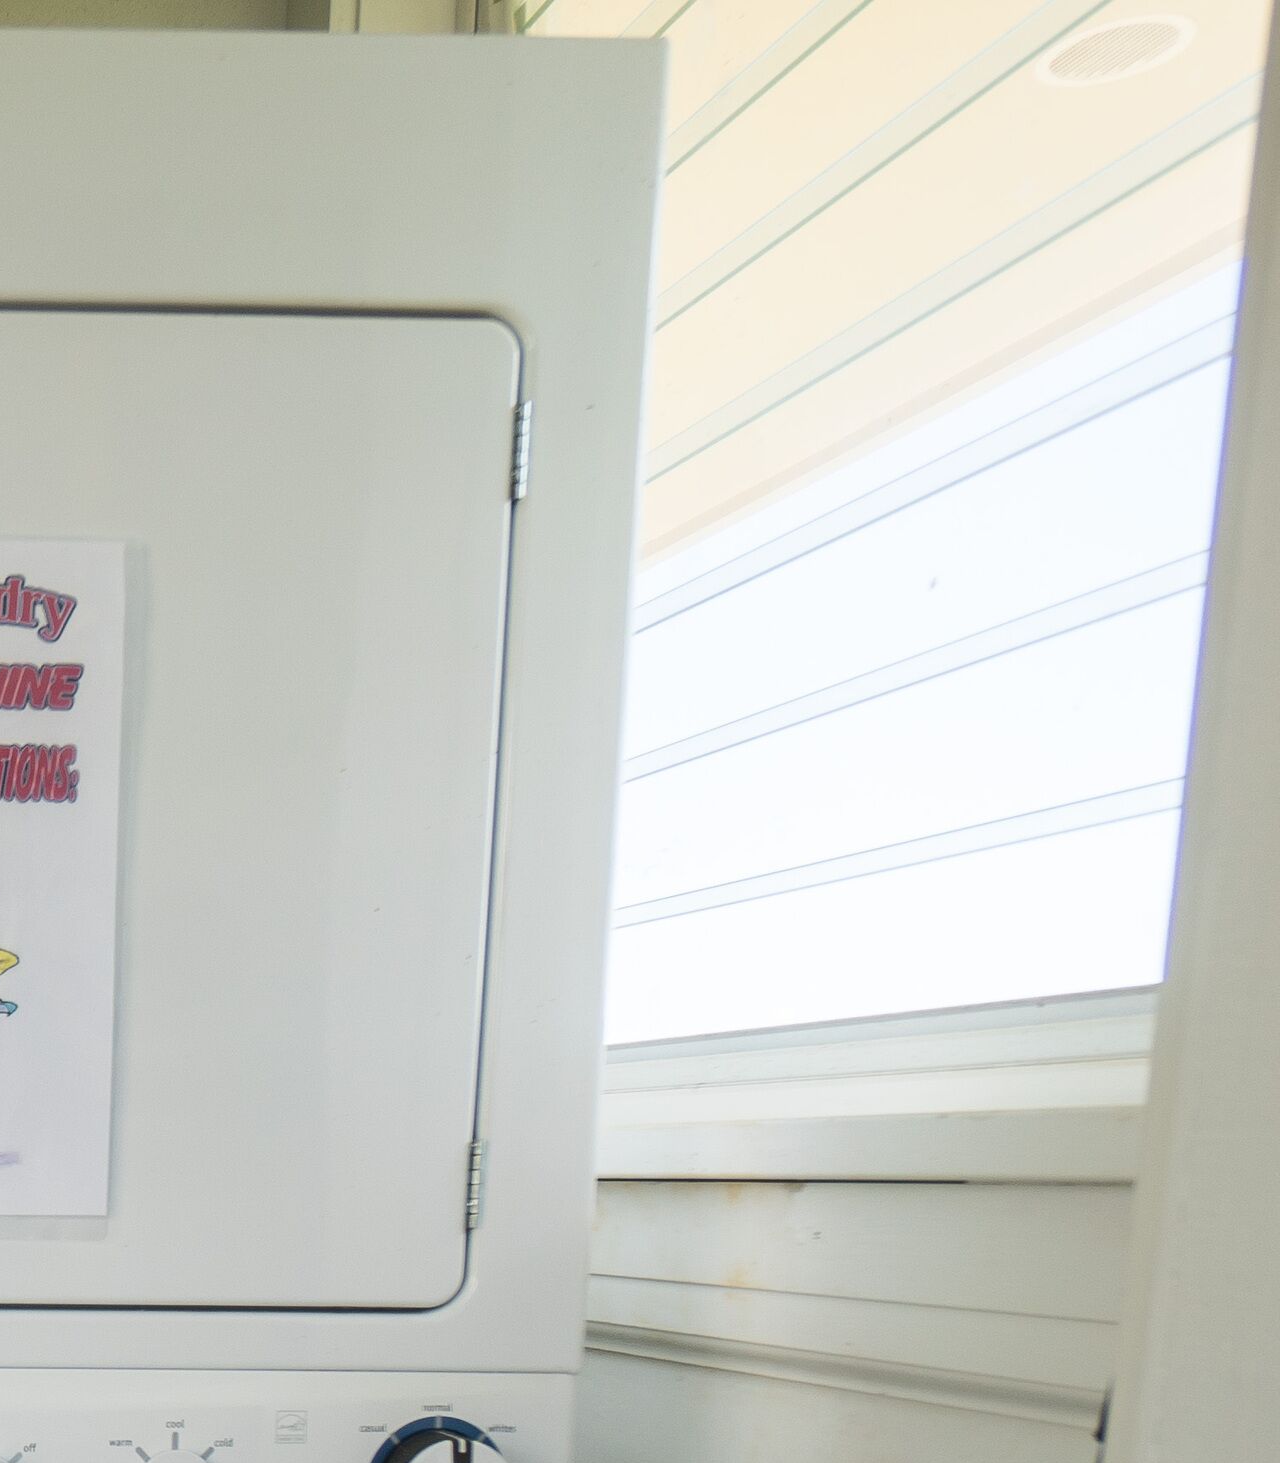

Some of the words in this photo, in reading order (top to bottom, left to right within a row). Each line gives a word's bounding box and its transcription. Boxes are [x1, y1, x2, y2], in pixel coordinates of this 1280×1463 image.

[165, 1419, 185, 1429] cool
[23, 1443, 37, 1453] off
[109, 1439, 133, 1447] warm
[213, 1438, 235, 1448] cold
